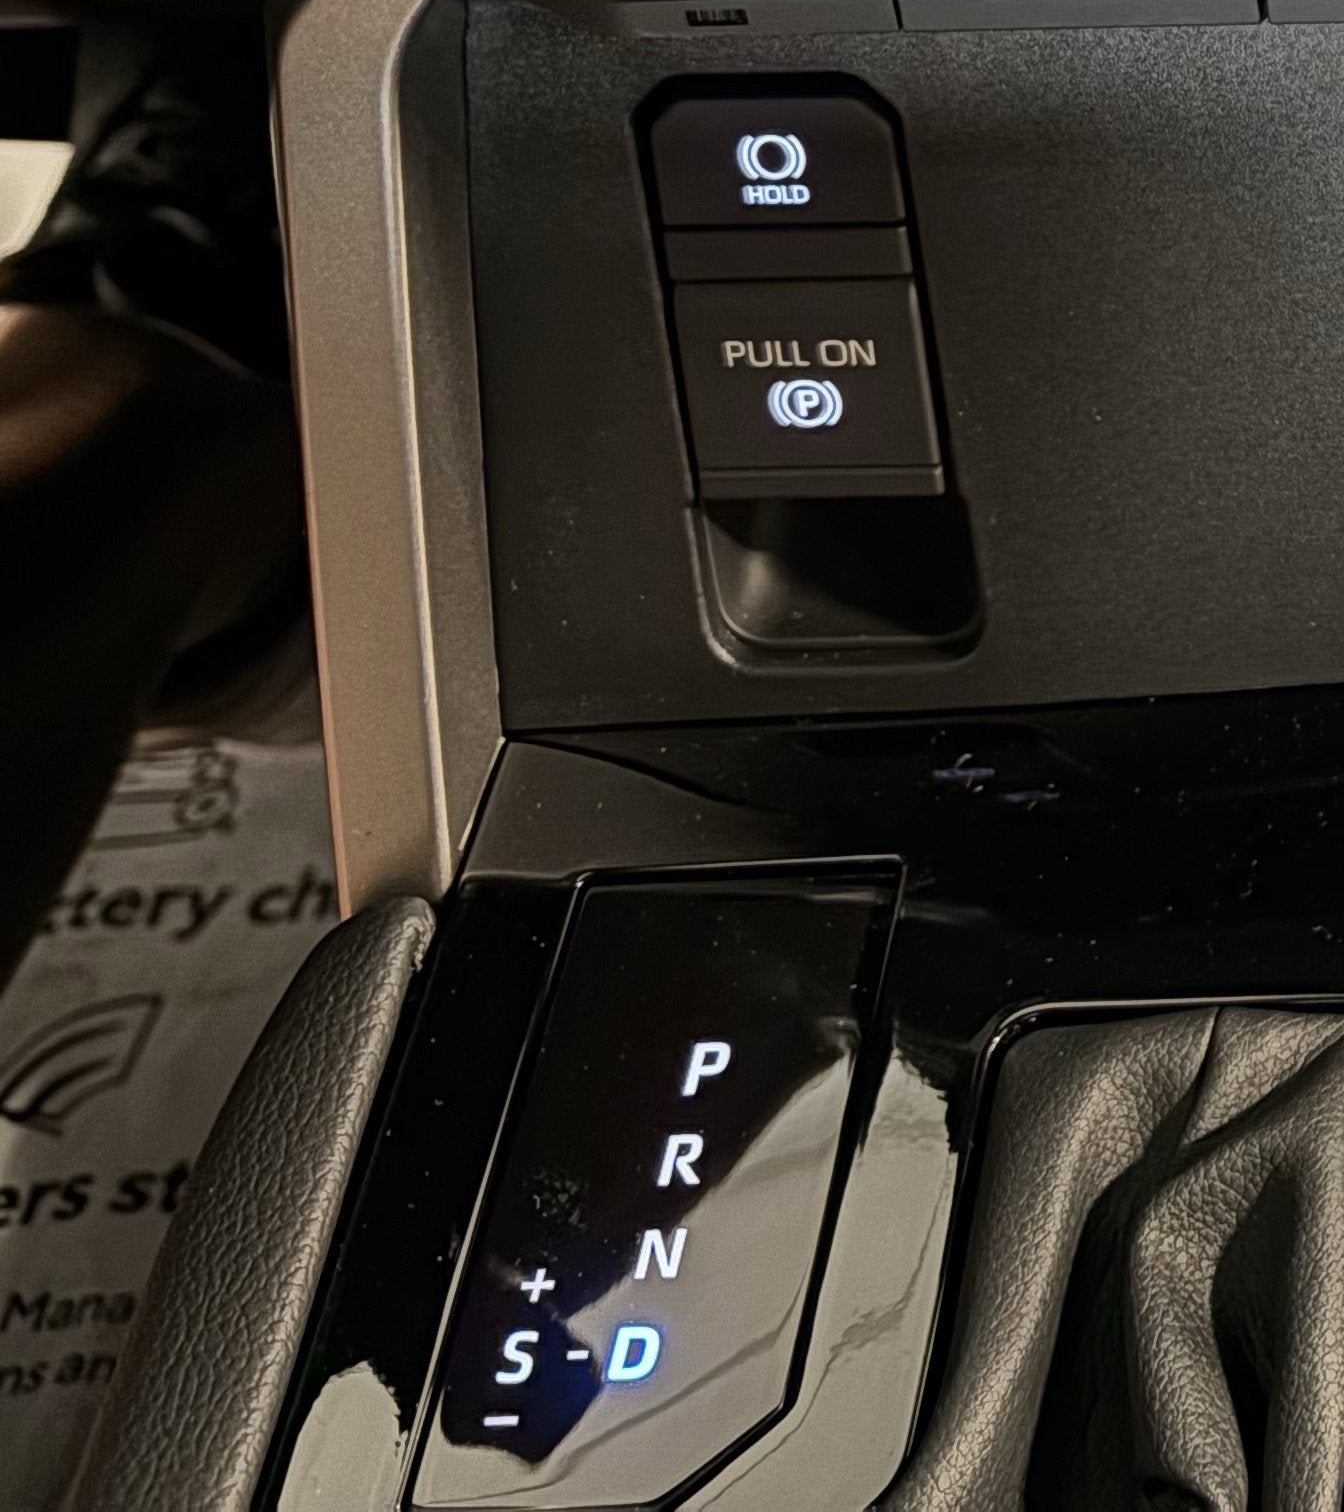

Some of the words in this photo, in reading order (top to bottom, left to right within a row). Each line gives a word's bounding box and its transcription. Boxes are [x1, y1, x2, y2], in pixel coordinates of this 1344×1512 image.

[742, 184, 811, 206] HOLD
[722, 339, 811, 368] PULL
[817, 338, 877, 368] ON
[681, 1040, 732, 1098] P
[657, 1133, 705, 1188] R
[632, 1227, 689, 1281] N
[494, 1329, 541, 1386] S
[605, 1325, 662, 1383] D
